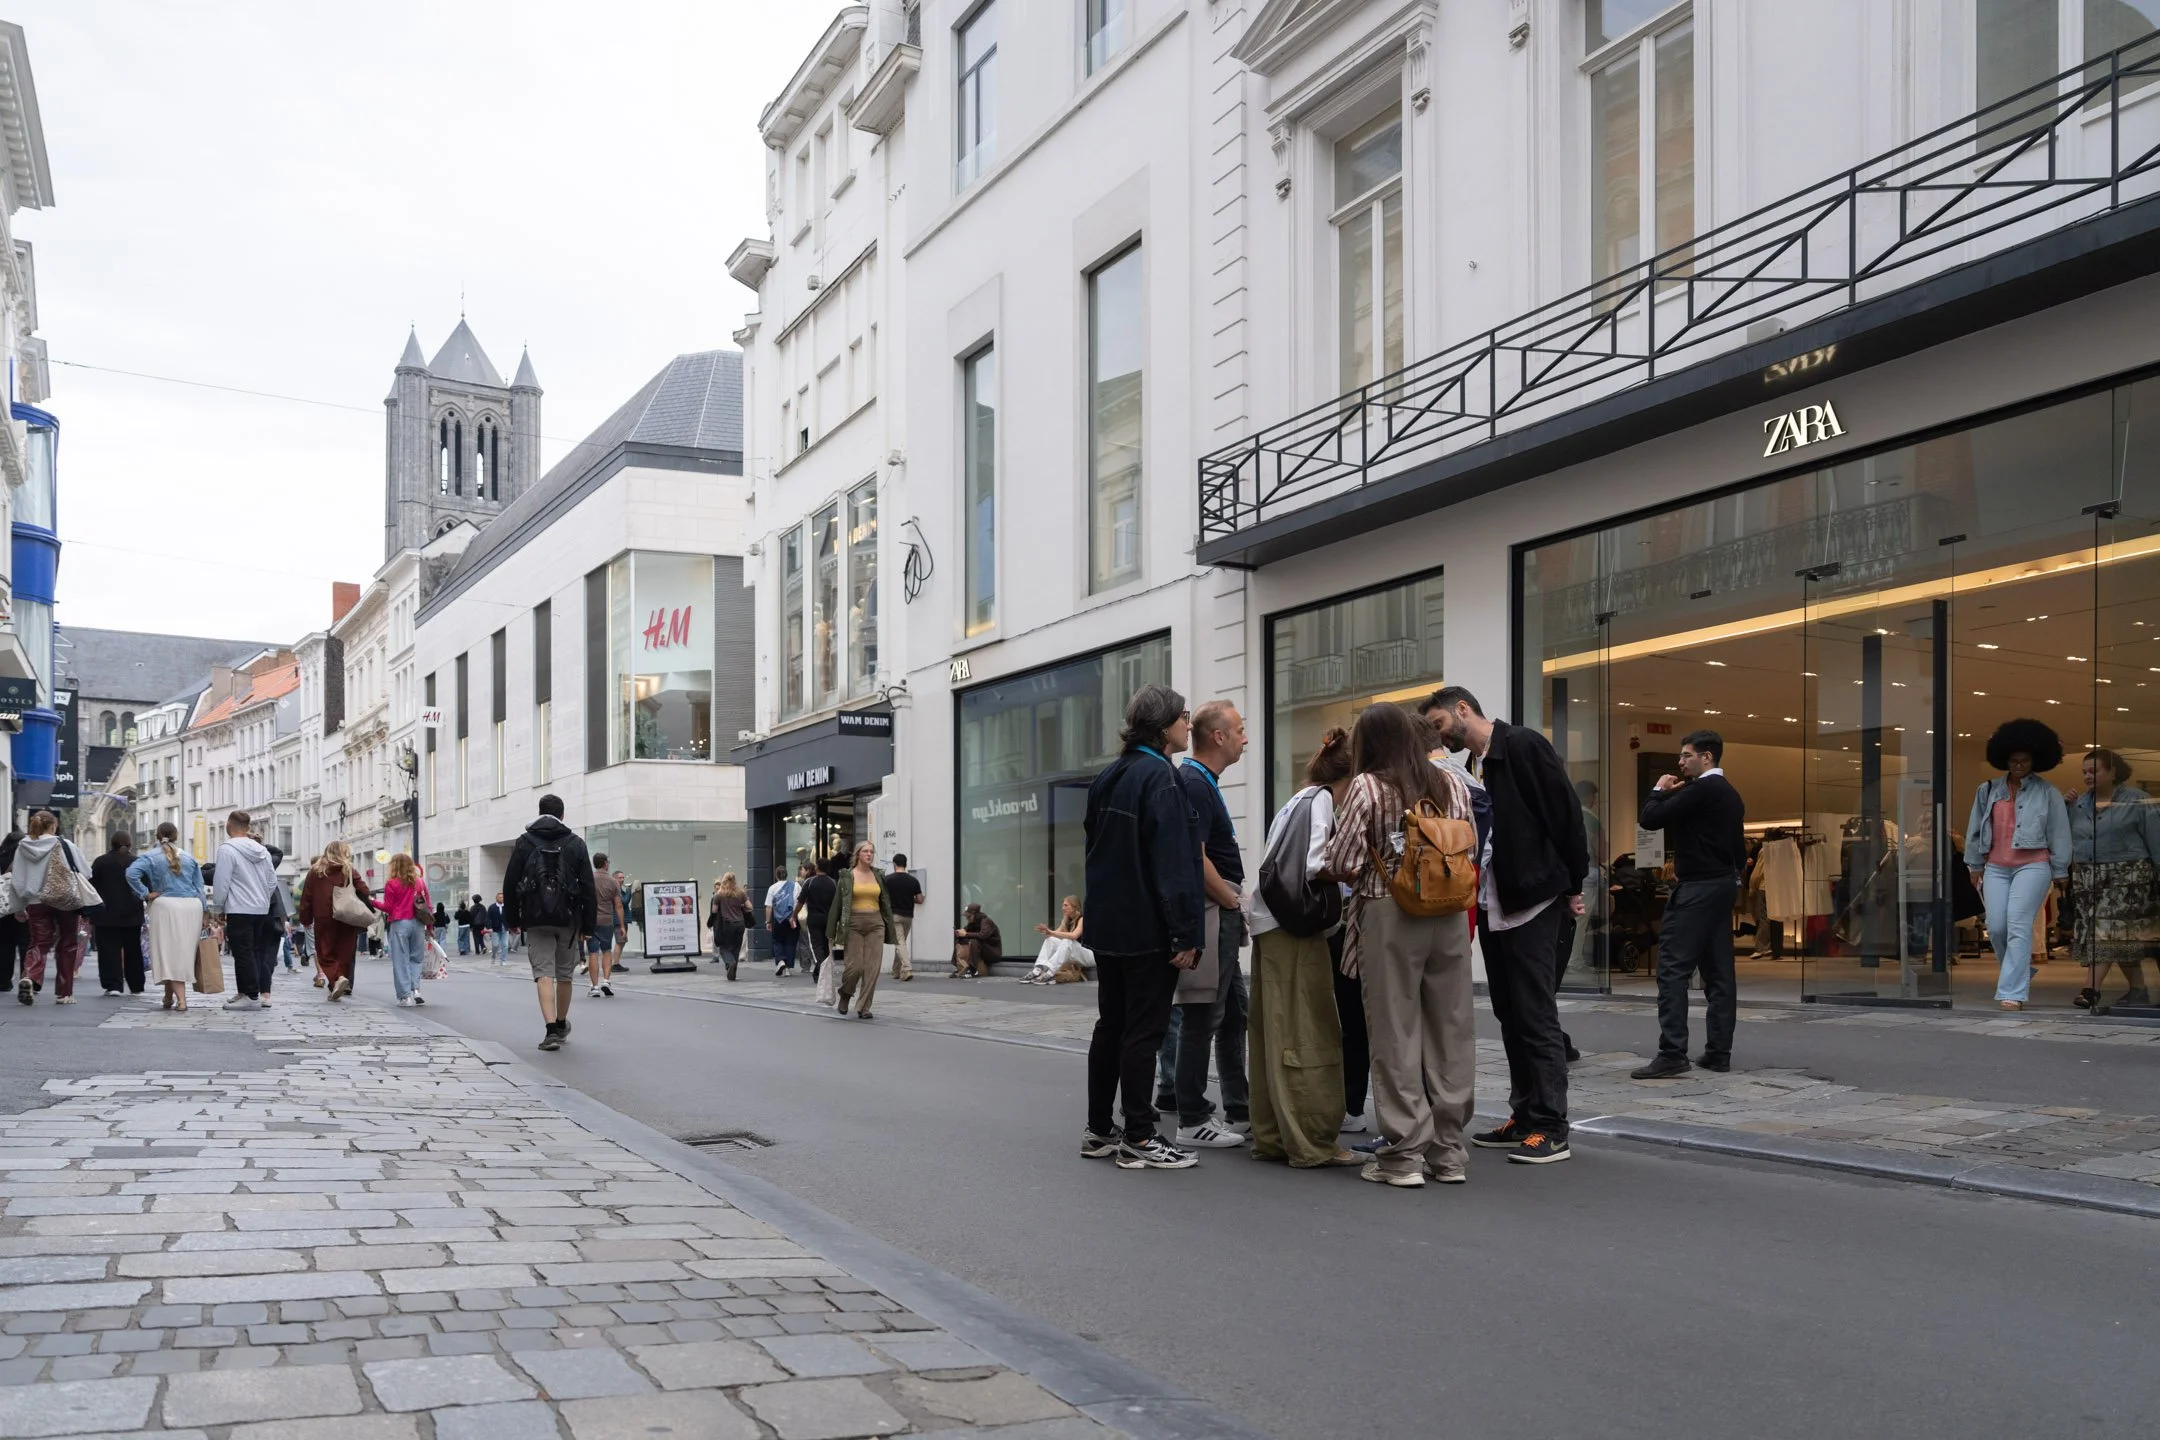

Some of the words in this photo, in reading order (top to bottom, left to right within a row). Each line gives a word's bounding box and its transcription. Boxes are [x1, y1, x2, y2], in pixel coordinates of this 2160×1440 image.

[1763, 400, 1847, 458] ZARA
[642, 605, 692, 650] H&M
[840, 715, 862, 725] WAM
[864, 717, 889, 726] DENIM
[787, 772, 805, 791] WAM
[806, 766, 829, 787] DENIM
